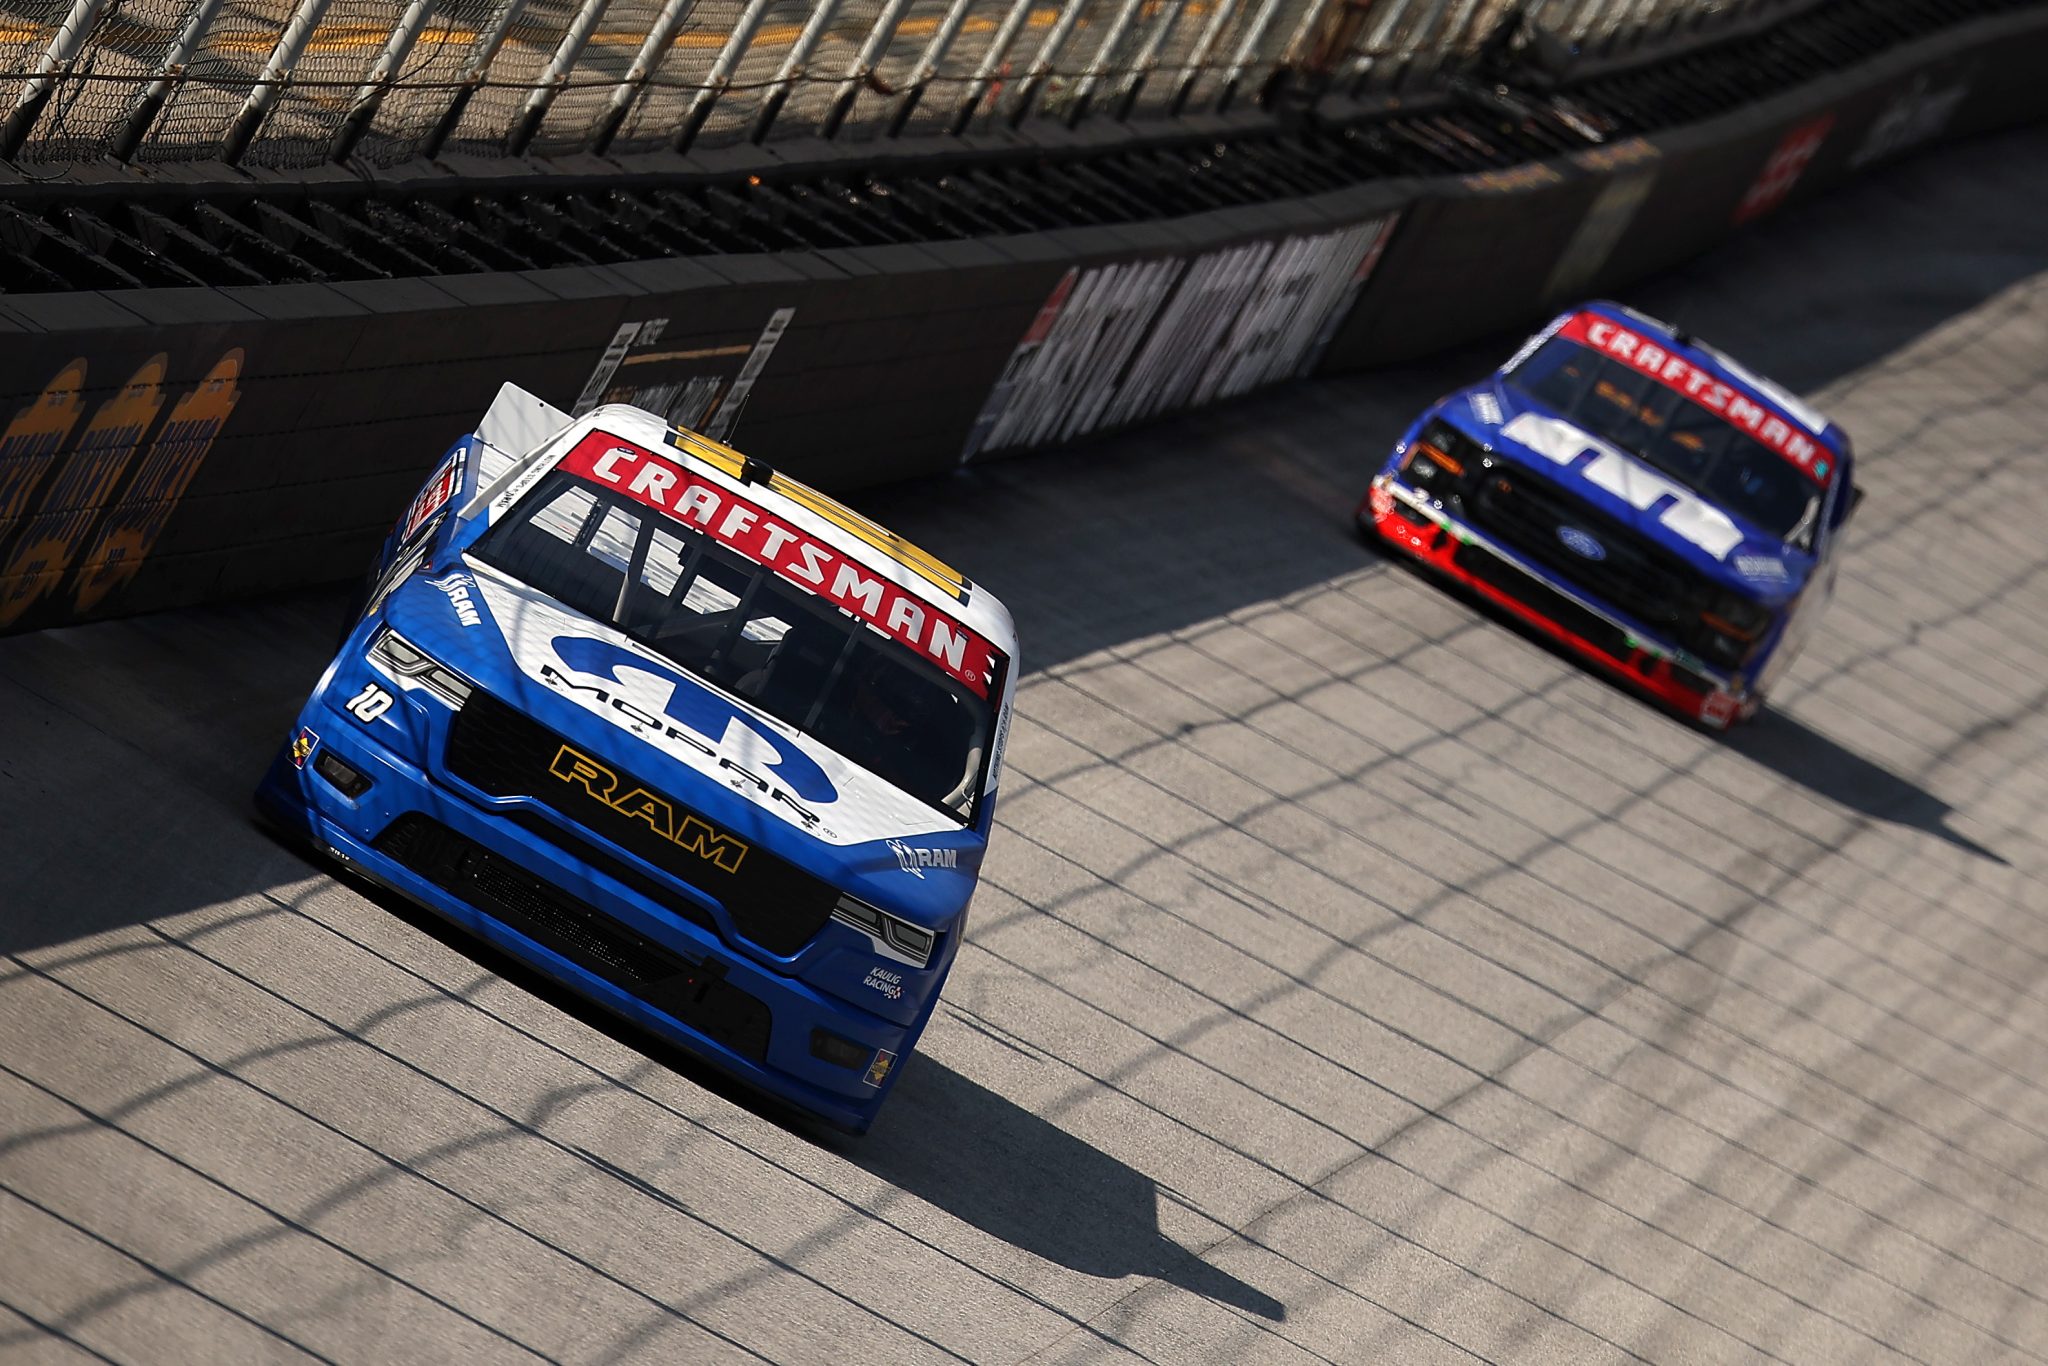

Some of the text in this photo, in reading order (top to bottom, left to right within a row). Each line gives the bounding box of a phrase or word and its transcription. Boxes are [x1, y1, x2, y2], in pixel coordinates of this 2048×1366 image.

[1587, 321, 1816, 464] CRAFTSMAN
[592, 447, 967, 672] CRAFTSMAN
[447, 586, 482, 627] RAM
[344, 681, 395, 724] 10
[540, 664, 821, 824] MOPAR
[549, 744, 749, 874] RAM
[914, 848, 957, 868] RAM
[863, 975, 896, 995] RACING
[870, 966, 902, 984] KAULIG
